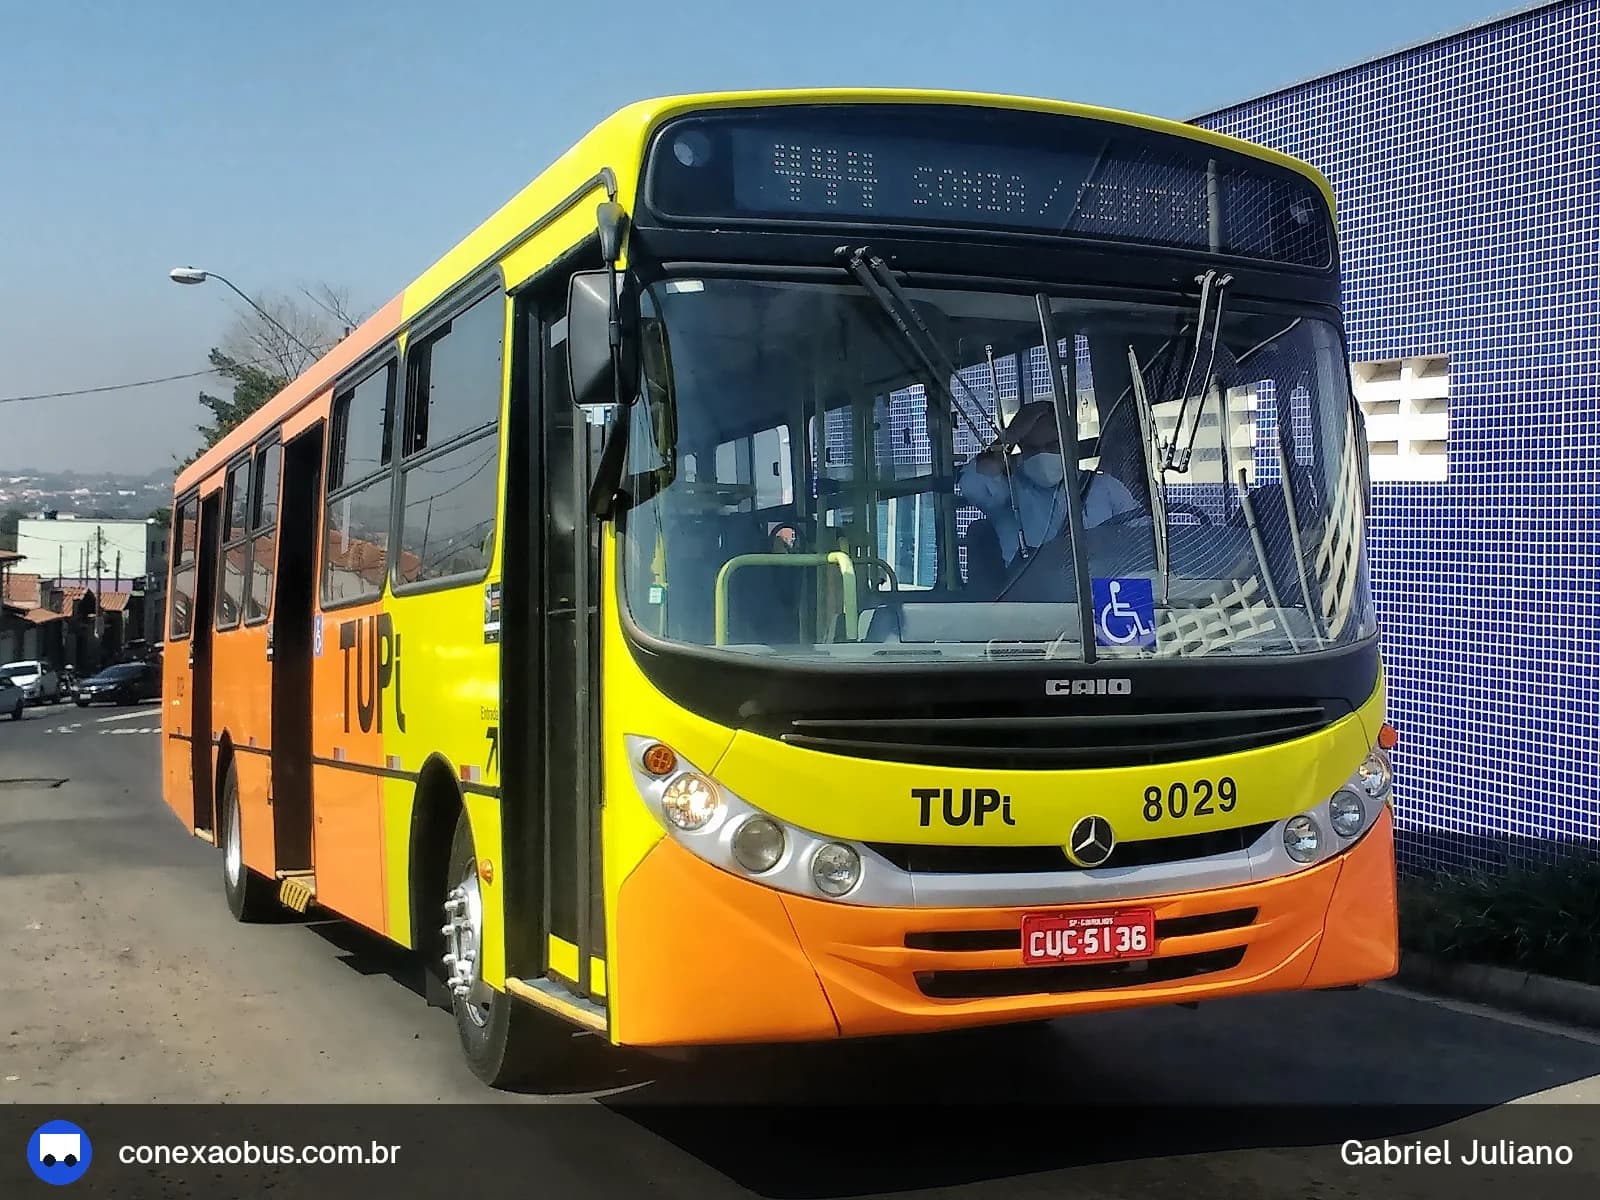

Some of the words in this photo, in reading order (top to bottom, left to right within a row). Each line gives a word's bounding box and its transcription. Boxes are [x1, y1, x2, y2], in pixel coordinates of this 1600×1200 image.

[774, 143, 879, 208] 444
[912, 166, 1026, 214] SONIA
[1076, 182, 1211, 229] CENTRO
[1045, 678, 1132, 695] CAIO
[1143, 776, 1238, 822] 8029
